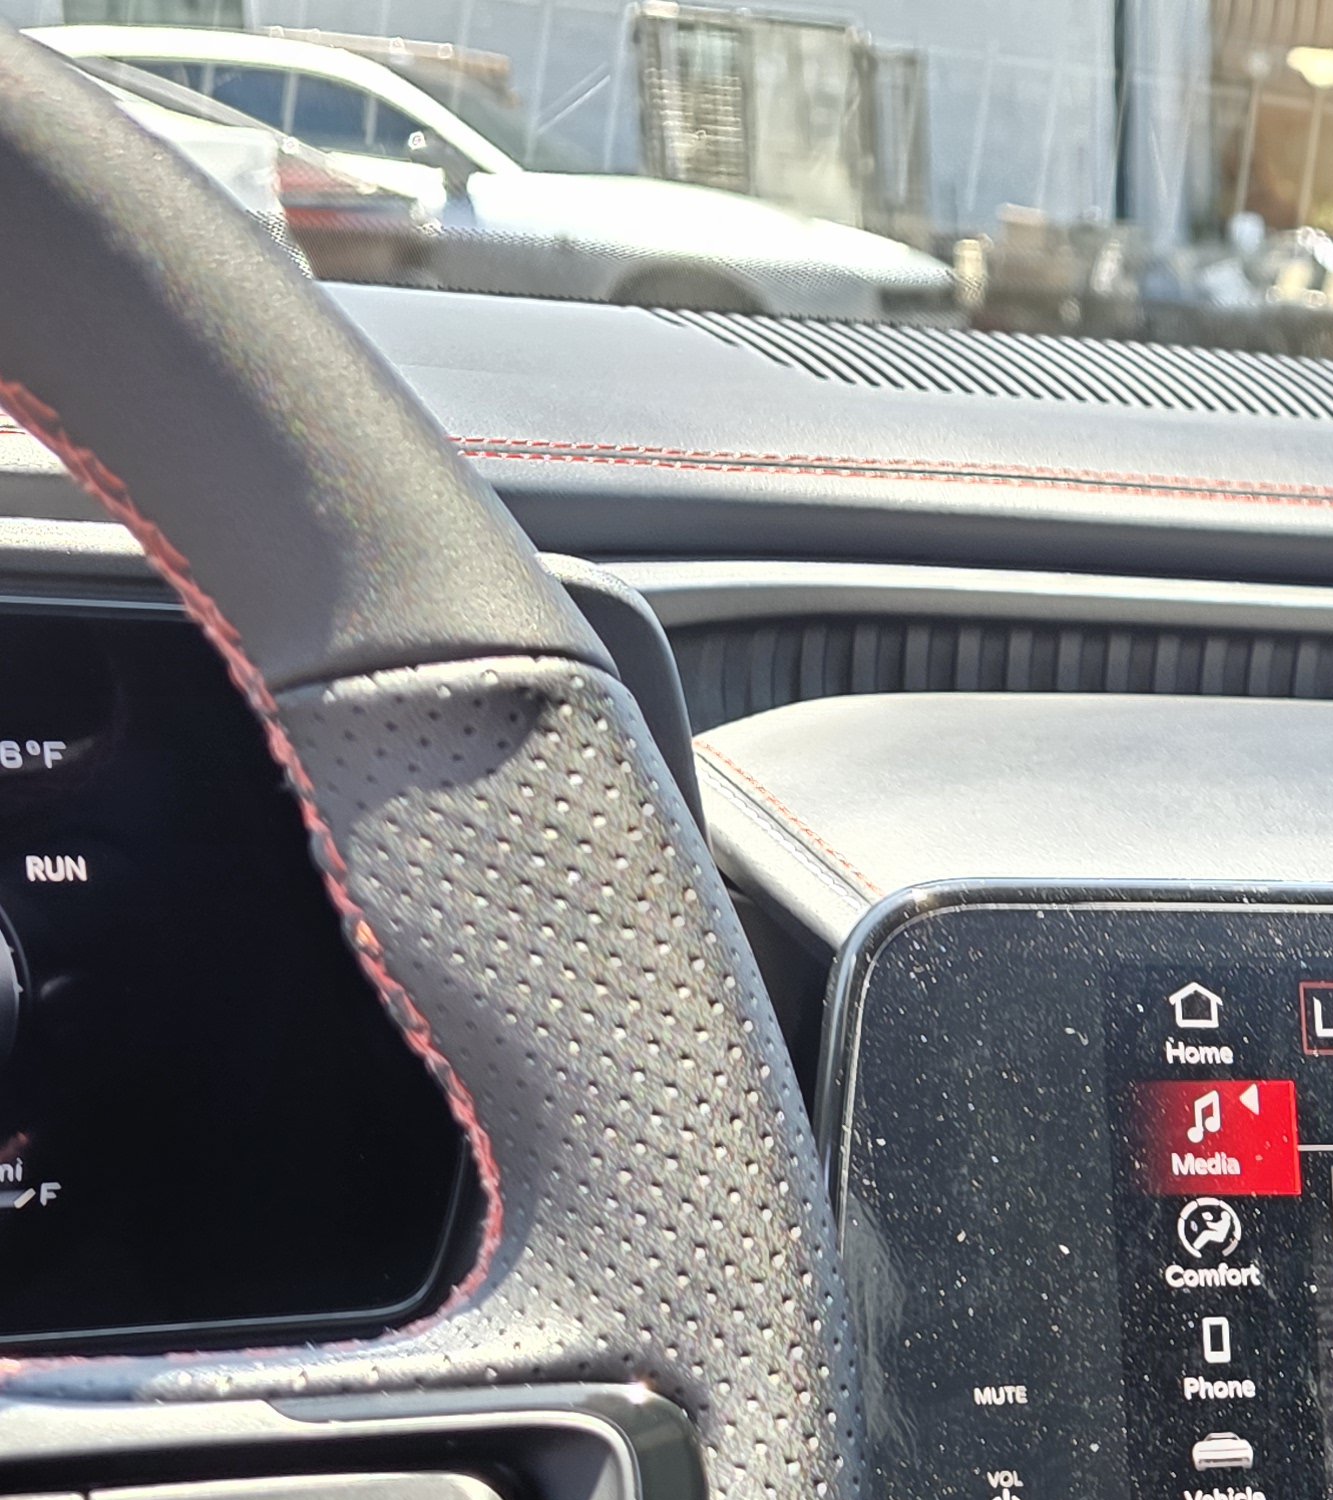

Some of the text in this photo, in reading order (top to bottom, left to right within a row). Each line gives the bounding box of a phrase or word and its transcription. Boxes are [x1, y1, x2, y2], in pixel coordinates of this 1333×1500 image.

[25, 854, 87, 882] RUN
[1166, 1041, 1234, 1066] Home
[1171, 1151, 1241, 1177] Media
[40, 1182, 62, 1207] F
[1165, 1264, 1261, 1289] Comfort
[974, 1385, 1028, 1407] MUTE
[1183, 1377, 1256, 1401] Phone
[987, 1470, 1023, 1489] VOL
